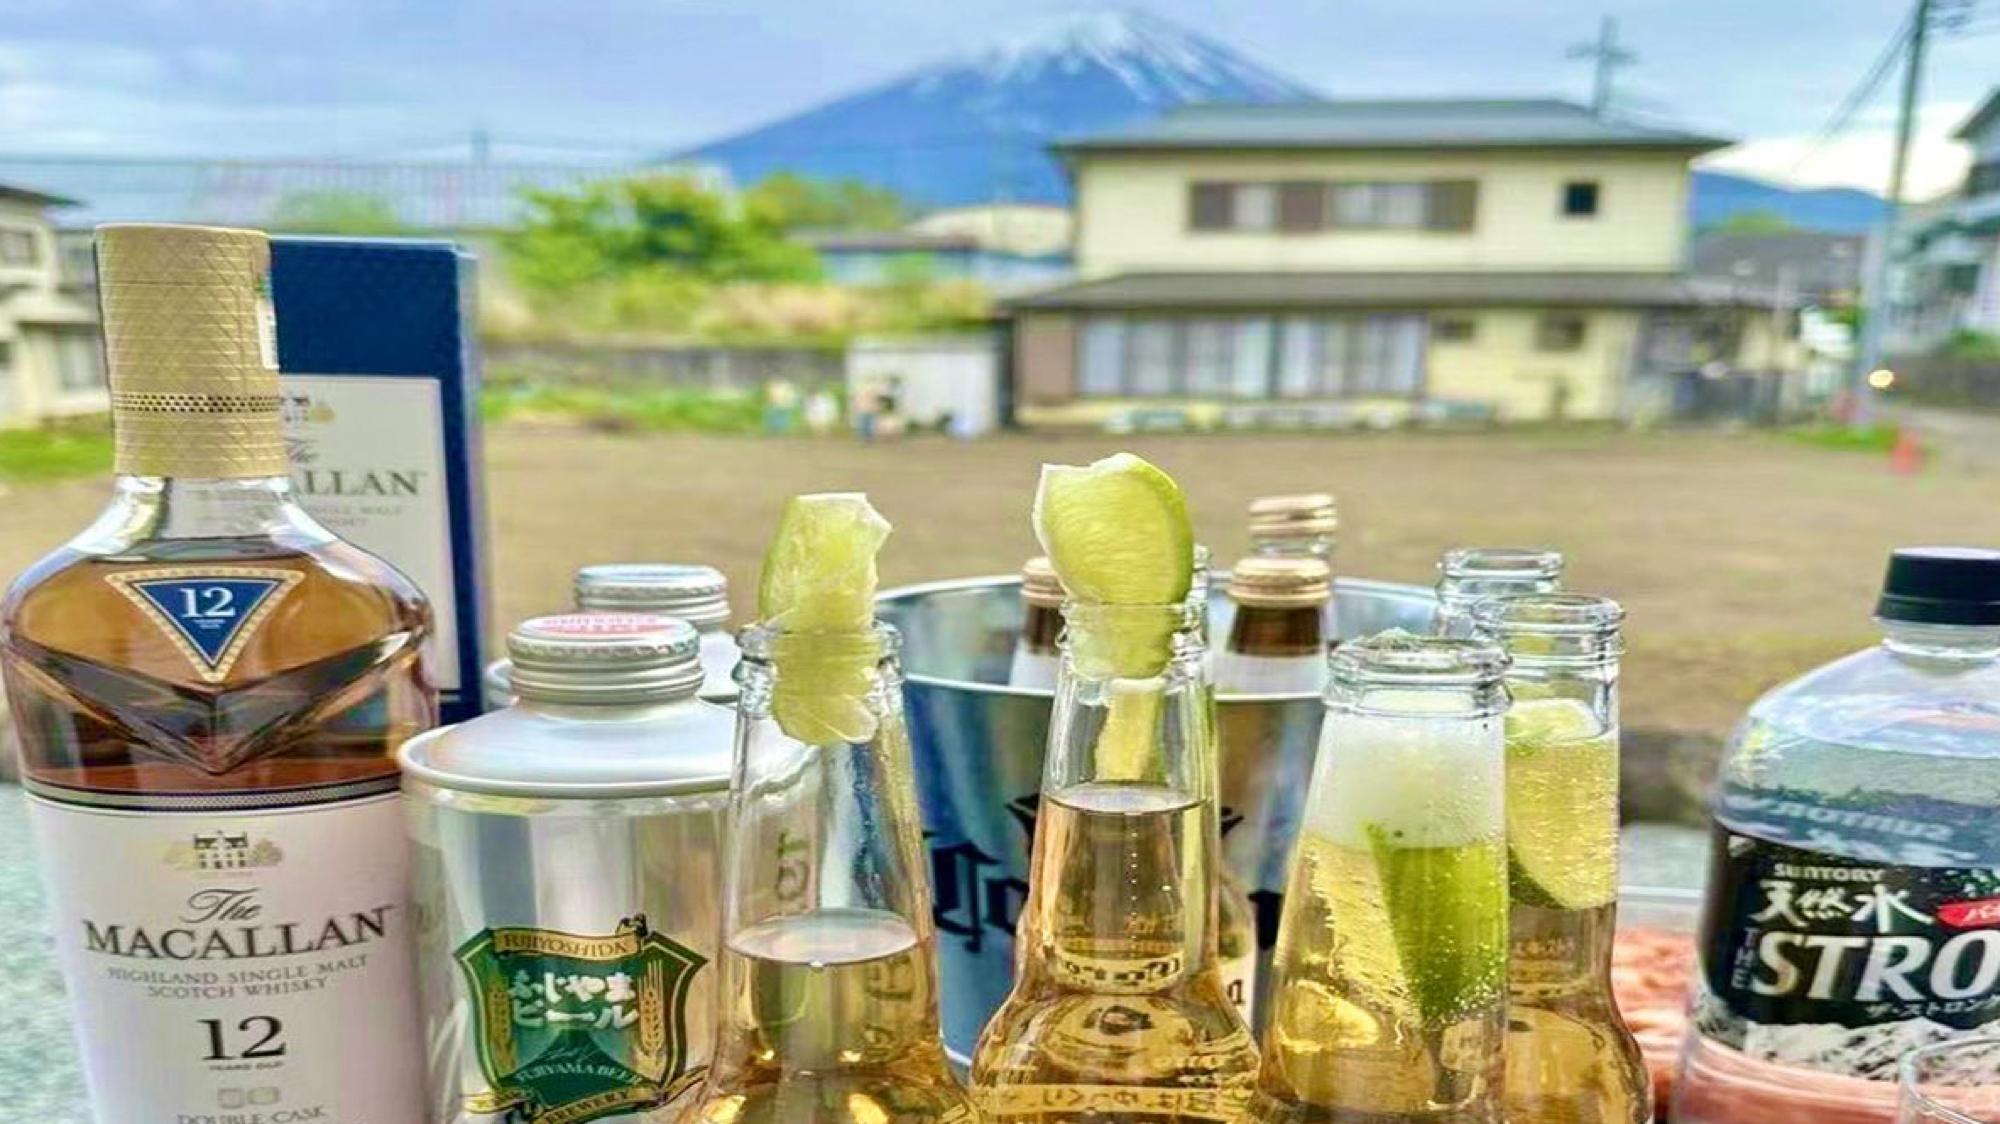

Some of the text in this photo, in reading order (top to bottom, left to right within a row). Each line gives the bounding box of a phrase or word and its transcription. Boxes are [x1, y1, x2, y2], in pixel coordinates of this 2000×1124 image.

[180, 586, 236, 618] 12
[1774, 863, 1885, 882] SUNTORY
[179, 887, 263, 924] The
[1749, 880, 1936, 933] 天然水
[82, 903, 396, 960] MACALLAN
[108, 953, 369, 986] HIGHLAND SINGLE MALT
[1751, 929, 2000, 1001] STRO
[147, 976, 329, 999] SCOTCH WHISKY
[509, 969, 637, 1003] ふじやま
[512, 1001, 640, 1030] ビール
[196, 1015, 287, 1062] 12
[271, 1105, 329, 1124] CASK
